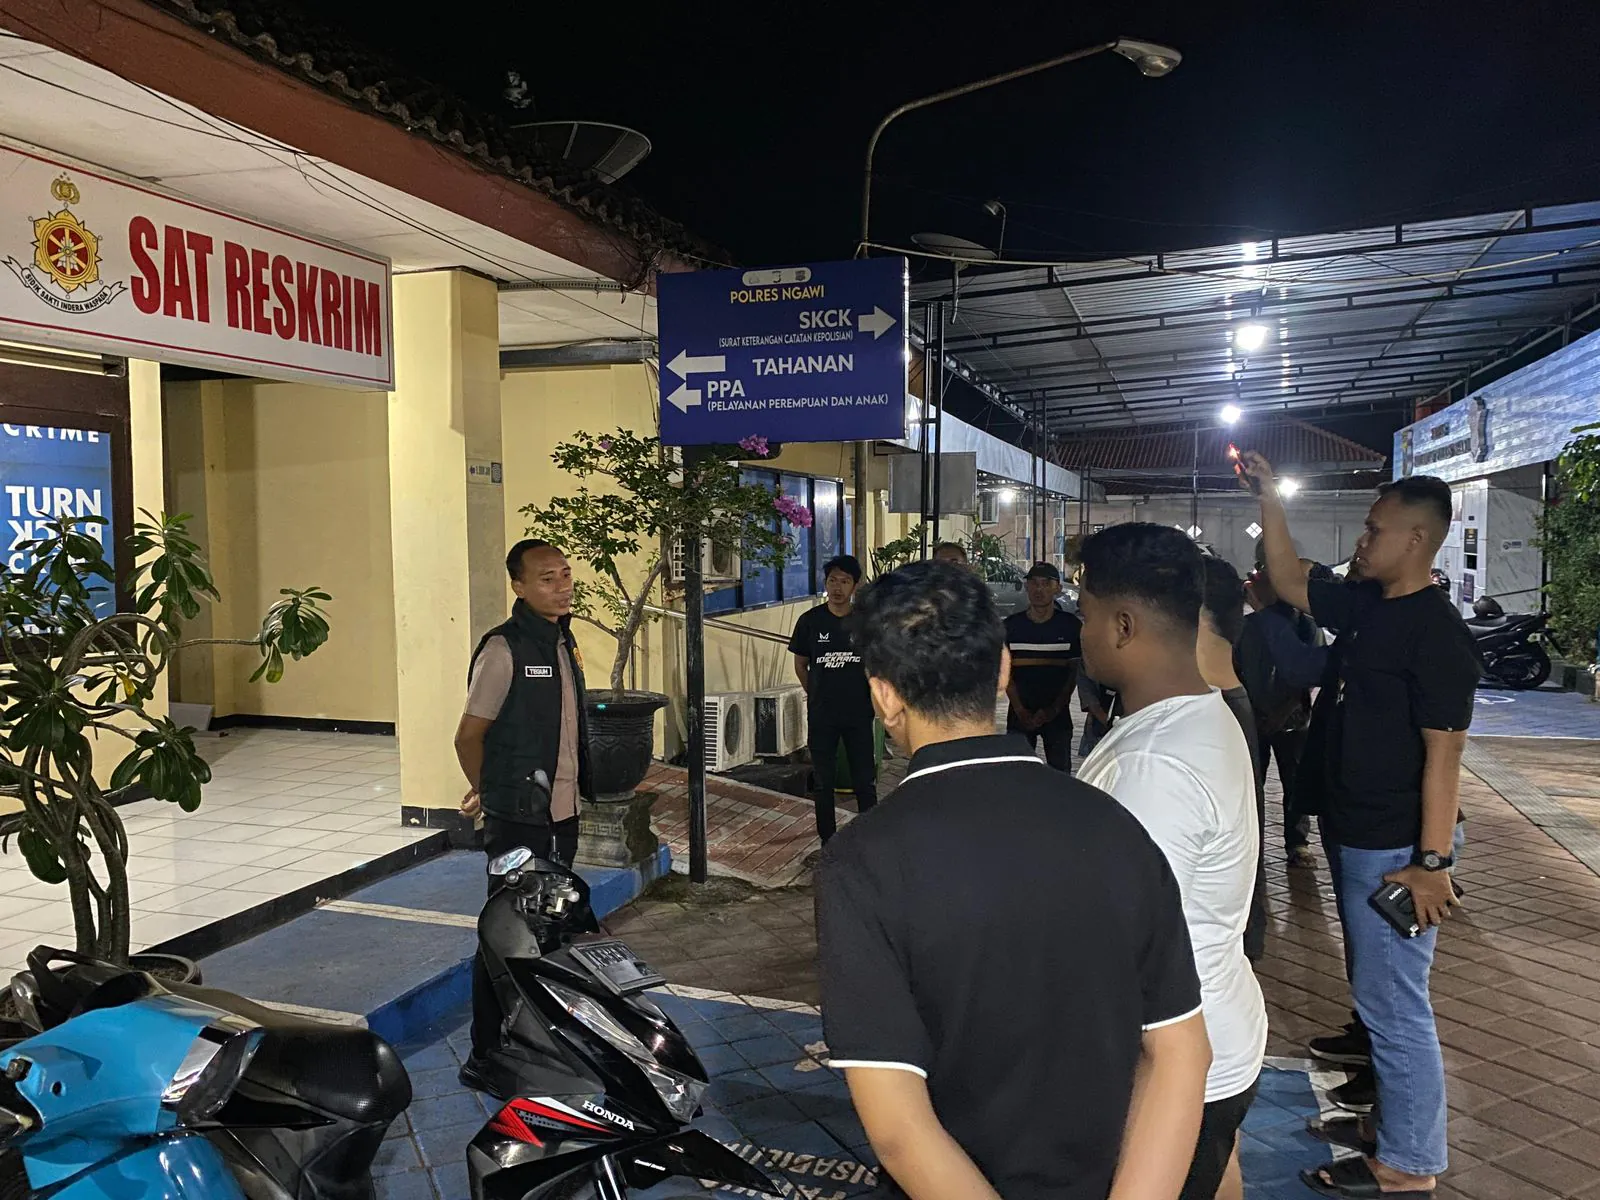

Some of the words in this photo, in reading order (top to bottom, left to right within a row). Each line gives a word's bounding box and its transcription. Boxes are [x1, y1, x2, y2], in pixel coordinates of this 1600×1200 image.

[25, 273, 42, 293] SIDIK
[40, 291, 59, 307] SAKTI
[60, 302, 84, 311] INDERA
[84, 291, 108, 310] WASPADA
[128, 215, 213, 323] SAT
[224, 240, 382, 357] RESKRIM
[730, 288, 779, 303] POLRES
[782, 285, 825, 300] NGAWI
[799, 308, 852, 329] SKCK
[741, 334, 782, 346] KETERANGAN
[784, 333, 812, 344] CATATAN
[752, 354, 853, 376] TAHANAN
[707, 379, 745, 398] PPA
[707, 400, 766, 412] (PELAYANAN
[769, 397, 829, 409] PEREMPUAN
[831, 396, 853, 407] DAN
[855, 393, 888, 406] ANAK)
[5, 485, 102, 518] TURN
[581, 1099, 635, 1131] HONDA
